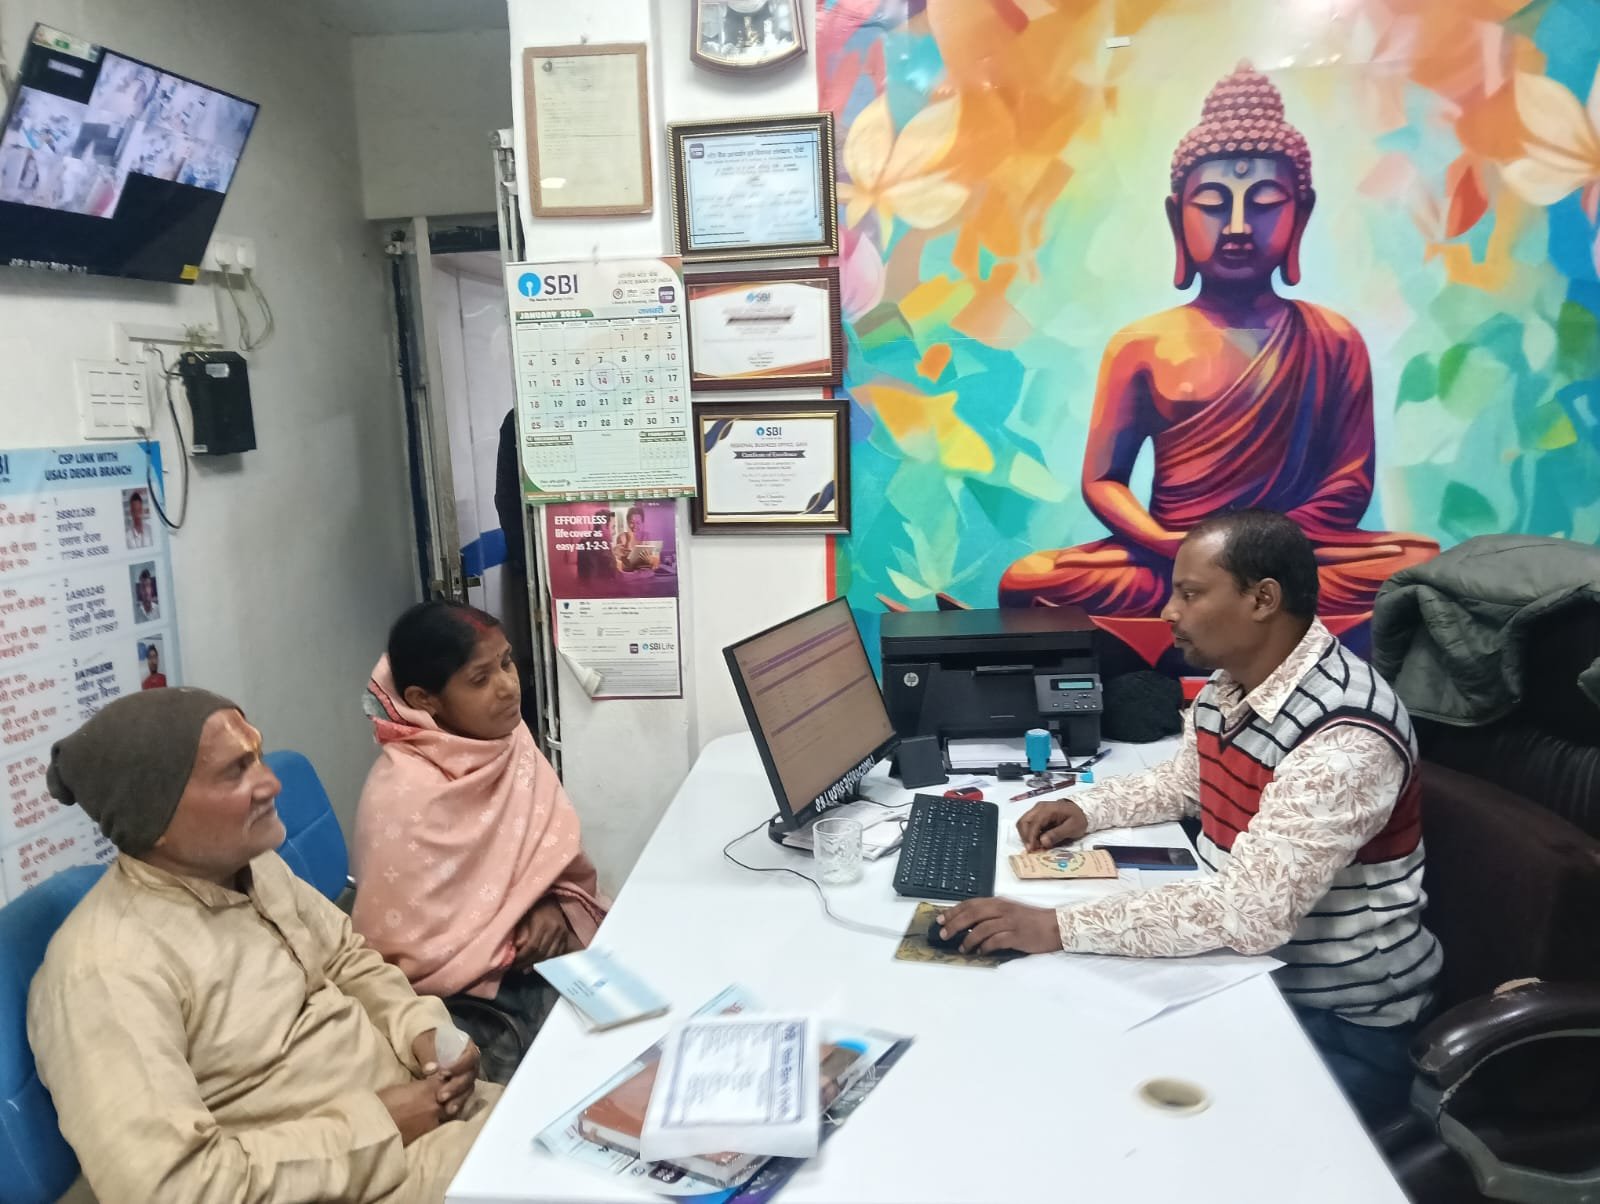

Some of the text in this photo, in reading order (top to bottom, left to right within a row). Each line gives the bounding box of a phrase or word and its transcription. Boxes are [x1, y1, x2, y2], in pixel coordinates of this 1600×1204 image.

[544, 274, 578, 295] SBI
[520, 311, 558, 320] JANUARY
[644, 332, 648, 341] 2
[667, 332, 672, 340] 3
[552, 358, 557, 366] 5
[552, 379, 561, 387] 12
[766, 427, 782, 436] SBI
[58, 452, 118, 464] CSP LINK WITH
[45, 468, 68, 481] USAS
[99, 465, 132, 476] BRANCH
[554, 515, 607, 525] EFFORTLESS
[555, 529, 569, 538] life
[569, 530, 592, 538] cover
